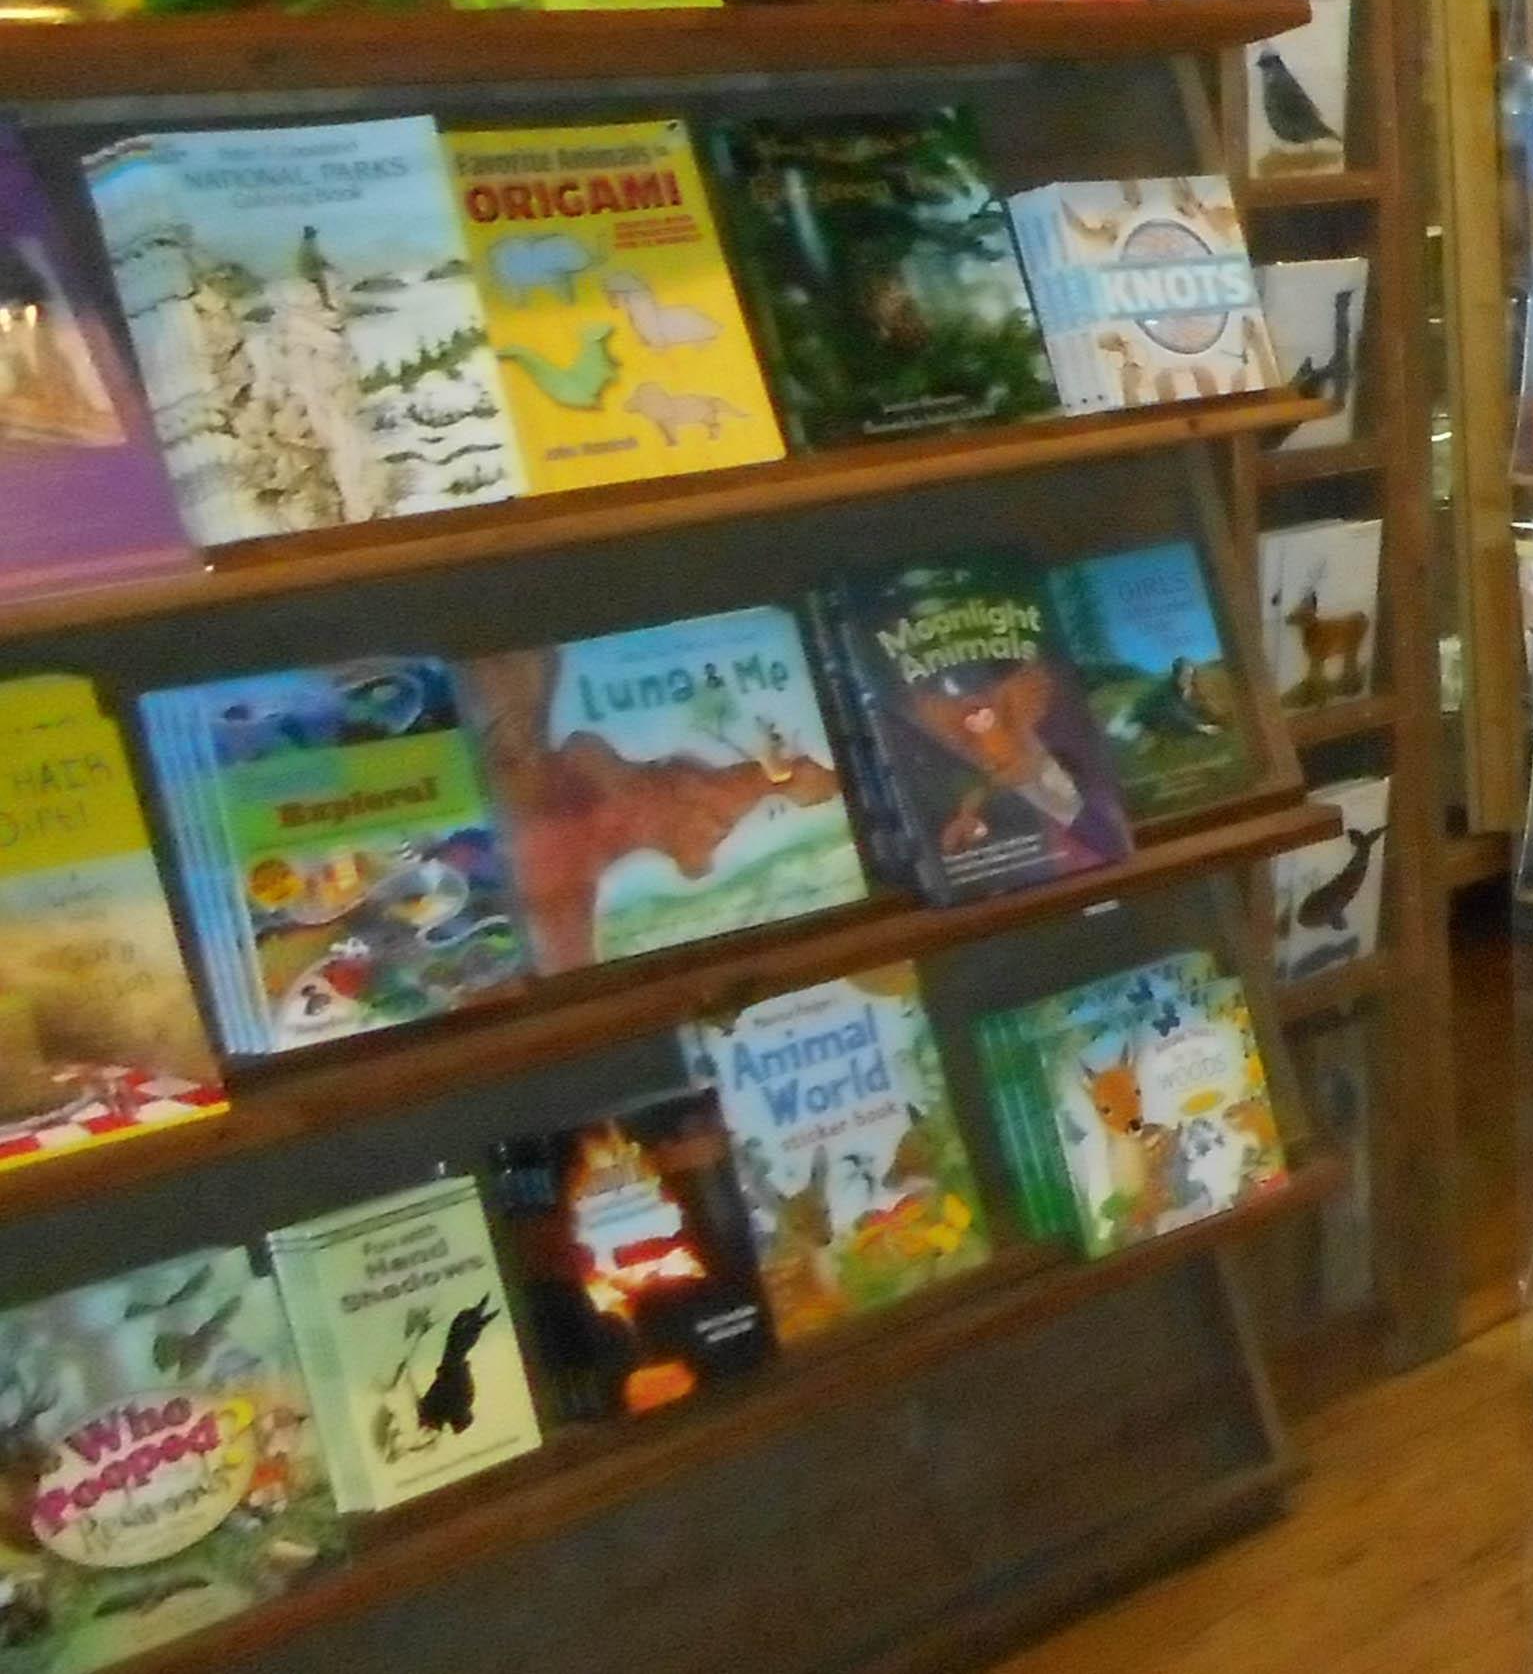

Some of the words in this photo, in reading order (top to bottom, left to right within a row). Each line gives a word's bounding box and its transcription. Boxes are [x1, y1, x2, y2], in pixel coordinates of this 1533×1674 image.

[464, 171, 684, 224] ORIGAMI
[1105, 262, 1250, 313] KNOTS
[876, 599, 1042, 660] Moonlight
[900, 627, 1038, 685] Animals
[577, 666, 694, 722] Luna
[733, 1003, 879, 1090] Animal
[761, 1047, 892, 1127] World
[340, 1254, 487, 1314] Shadows
